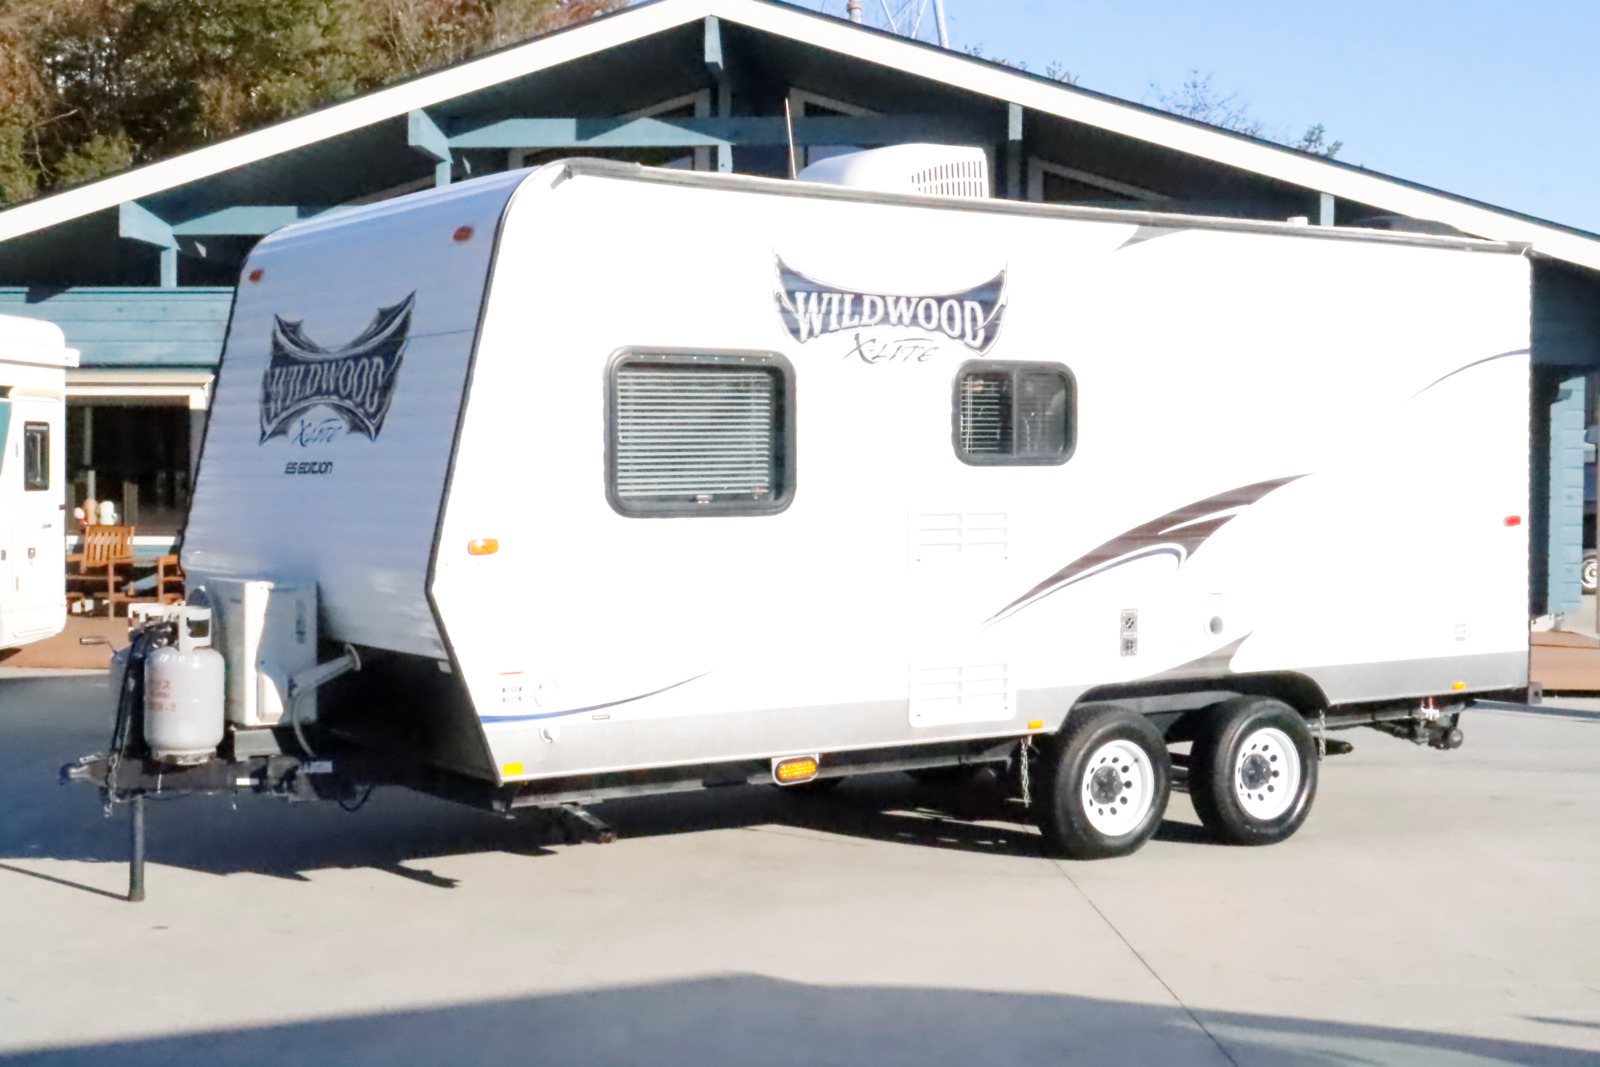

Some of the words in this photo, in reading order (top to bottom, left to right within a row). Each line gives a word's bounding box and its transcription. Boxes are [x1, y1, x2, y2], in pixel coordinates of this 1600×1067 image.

[795, 291, 986, 348] WILDWOOD
[843, 333, 940, 364] X-LITE
[266, 356, 385, 418] WILDWOOD
